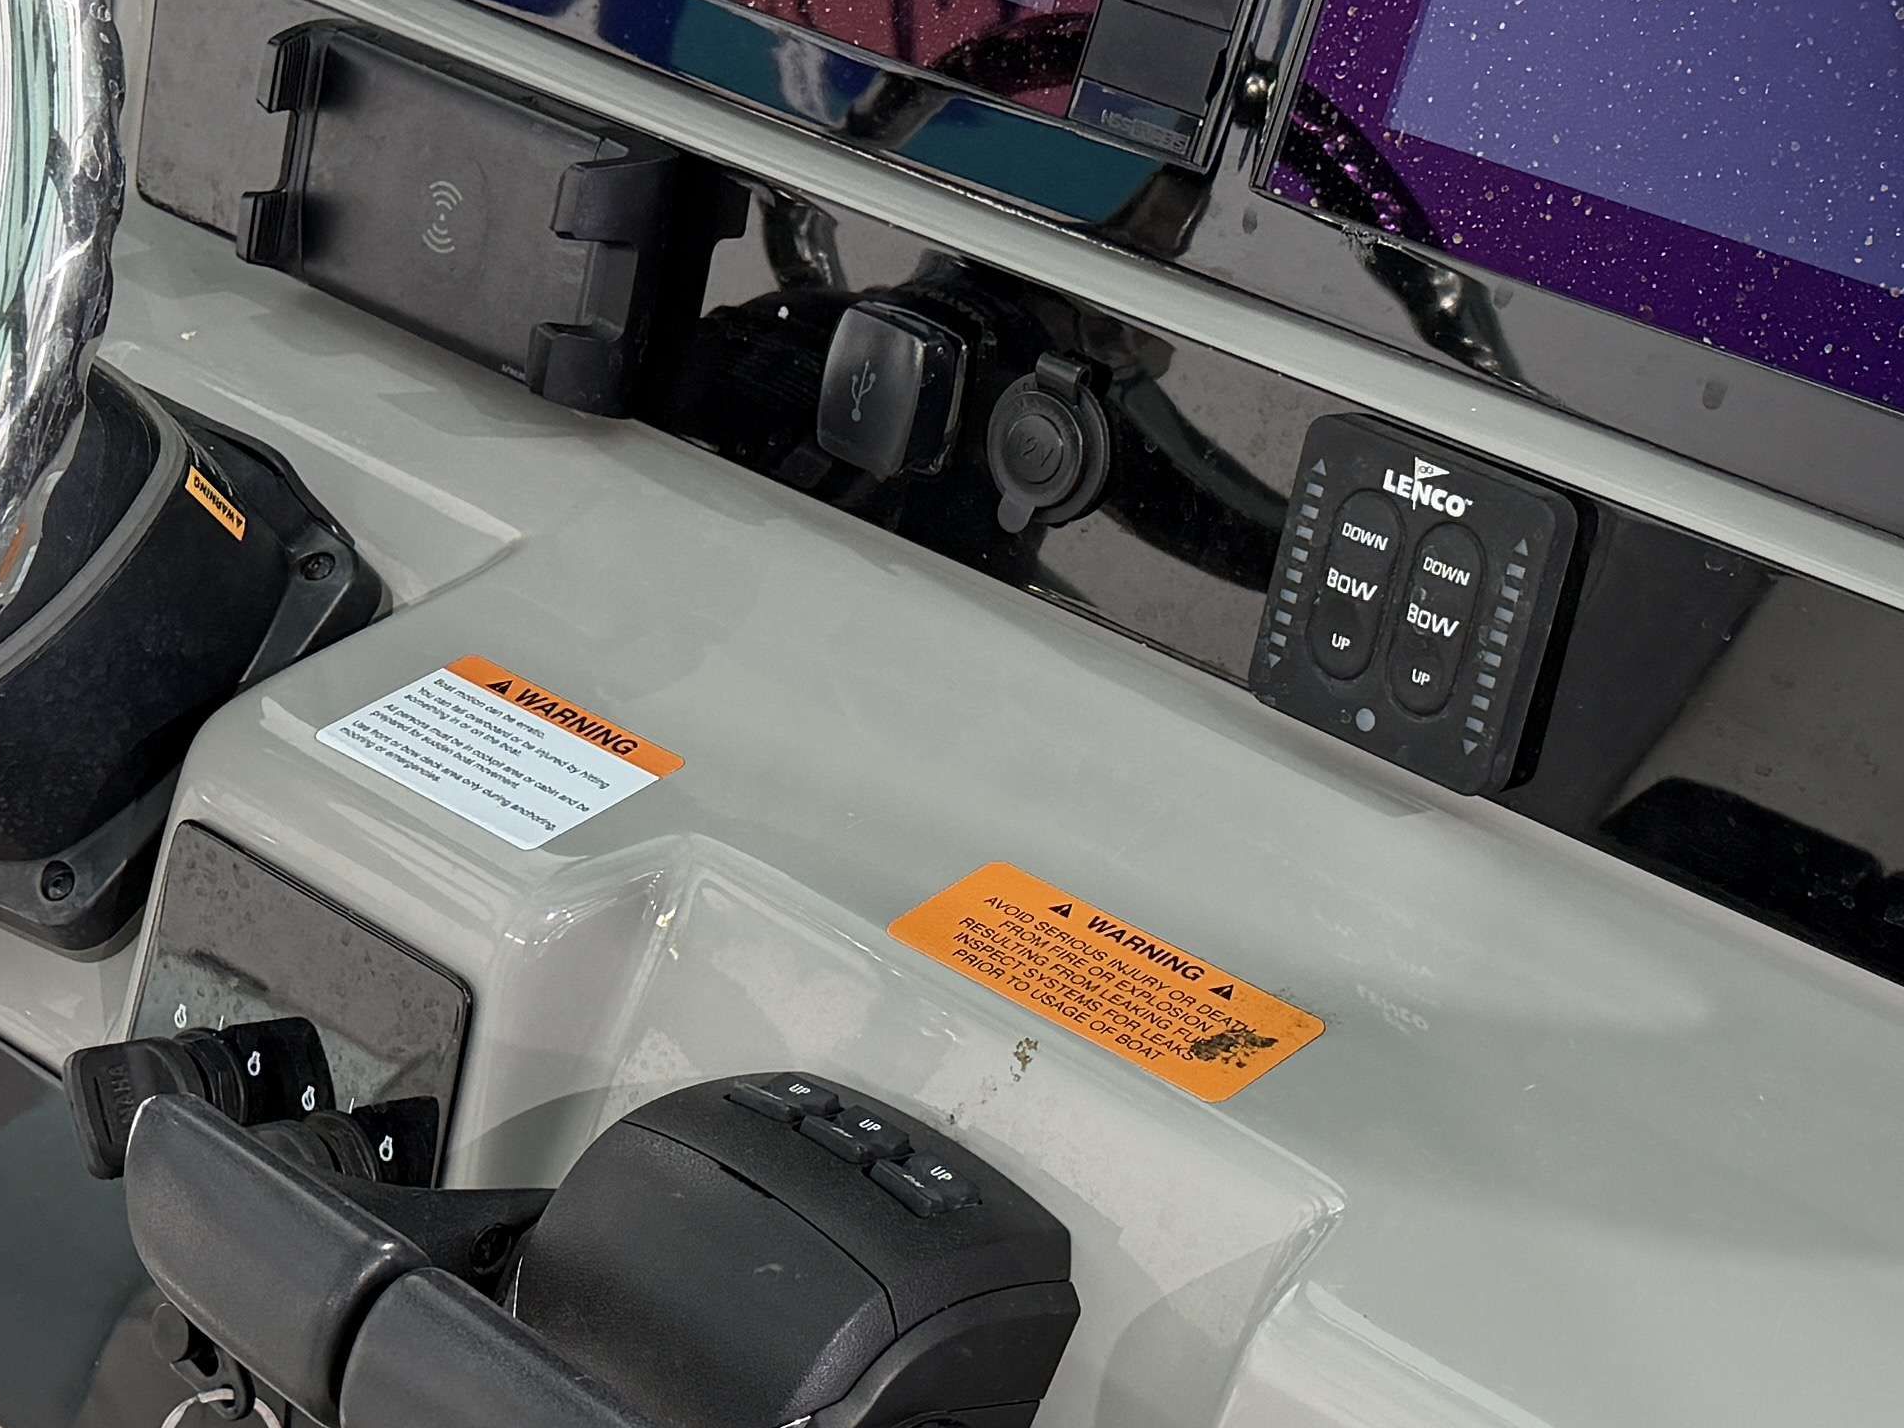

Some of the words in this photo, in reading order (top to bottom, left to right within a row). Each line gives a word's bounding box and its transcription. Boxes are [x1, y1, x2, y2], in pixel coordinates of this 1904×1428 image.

[1382, 467, 1467, 519] LENCO
[1341, 521, 1389, 552] DOWN
[1326, 567, 1378, 602] BOW
[1422, 555, 1471, 588] DOWN
[1406, 602, 1459, 638] BOW
[1330, 632, 1351, 651] UP
[1411, 667, 1431, 687] UP
[514, 688, 638, 757] WARNING
[983, 896, 1035, 923] AVOID
[1034, 921, 1108, 962] SERIOUS
[1106, 958, 1171, 991] INJURY
[1168, 990, 1196, 1008] OR
[1087, 915, 1205, 981] WARNING
[958, 916, 1049, 966] RESULTING
[1048, 963, 1101, 992] FROM
[1098, 988, 1173, 1030] LEAKING
[998, 920, 1050, 948] FROM
[1047, 945, 1089, 969] FIRE
[1087, 966, 1116, 983] OR
[1114, 979, 1214, 1033] EXPLOSION
[951, 948, 1006, 979] PRIOR
[1006, 975, 1030, 991] TO
[1030, 988, 1091, 1024] USAGE
[1089, 1020, 1118, 1034] OF
[1114, 1033, 1165, 1060] BOAT
[952, 931, 1026, 970] INSPECT
[1022, 967, 1103, 1012] SYSTEMS
[1101, 1008, 1141, 1032] FOR
[1139, 1027, 1201, 1061] LEAKS
[788, 1082, 811, 1097] UP
[858, 1118, 882, 1132] UP
[929, 1164, 953, 1182] UP
